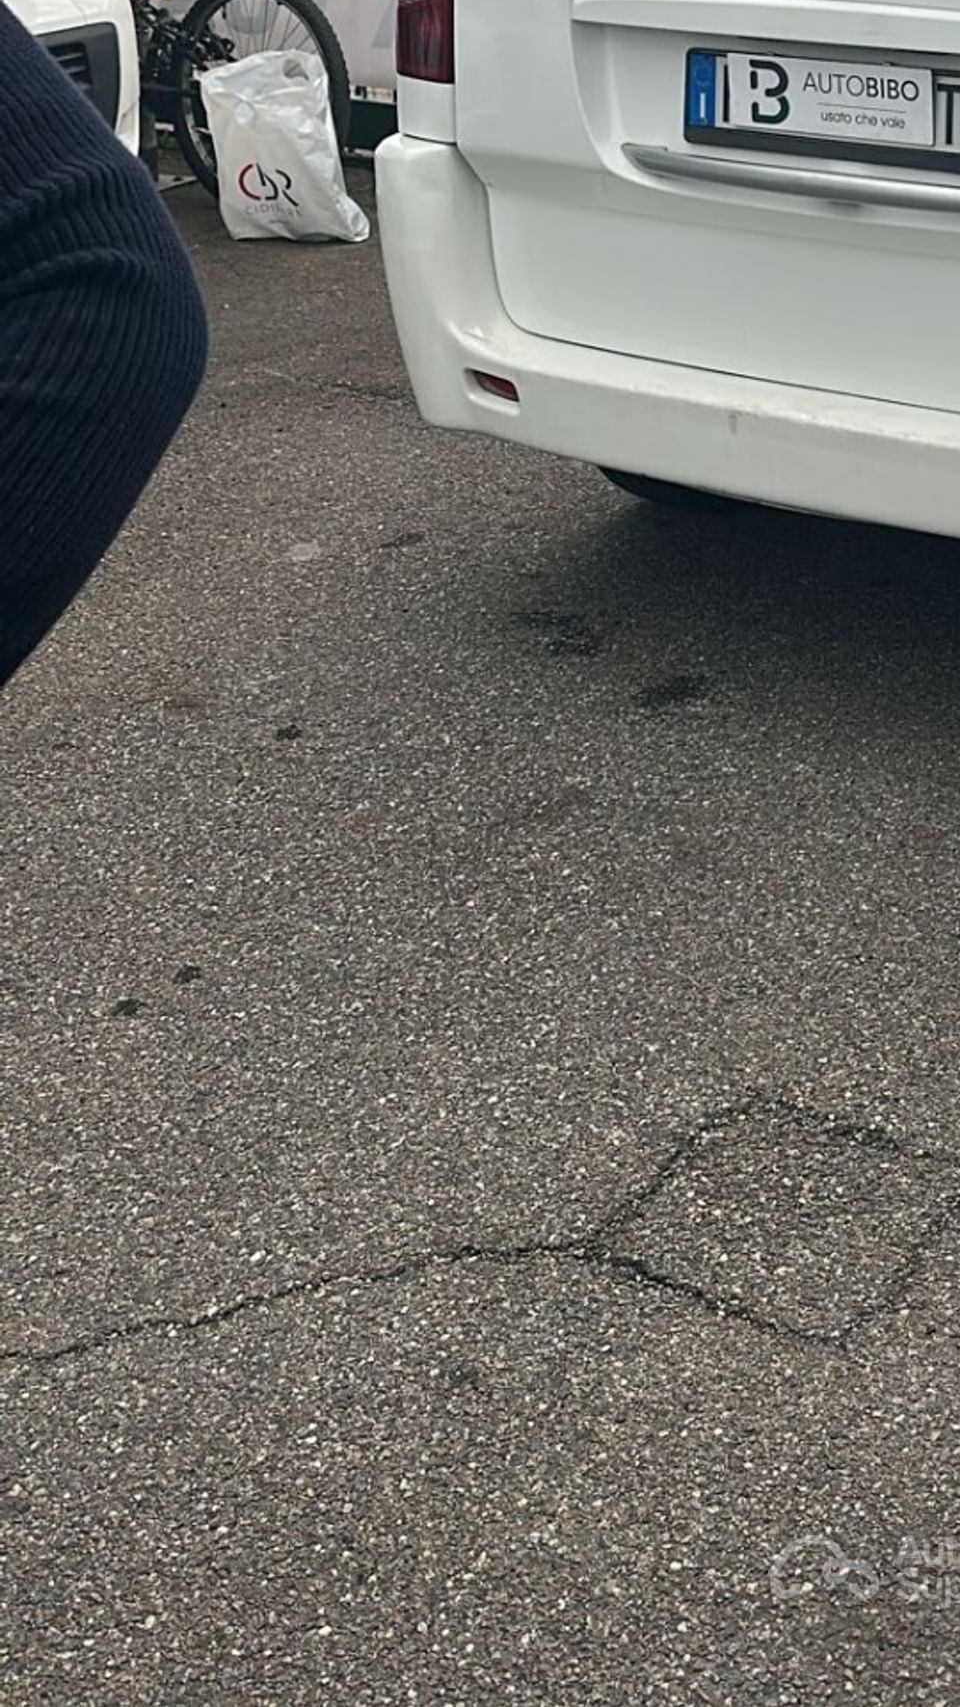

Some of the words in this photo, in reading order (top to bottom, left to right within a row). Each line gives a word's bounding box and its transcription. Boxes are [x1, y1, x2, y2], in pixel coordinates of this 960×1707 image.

[803, 72, 919, 101] AUTOBIBO
[821, 111, 852, 124] usato
[855, 114, 878, 126] che
[881, 117, 906, 130] vale
